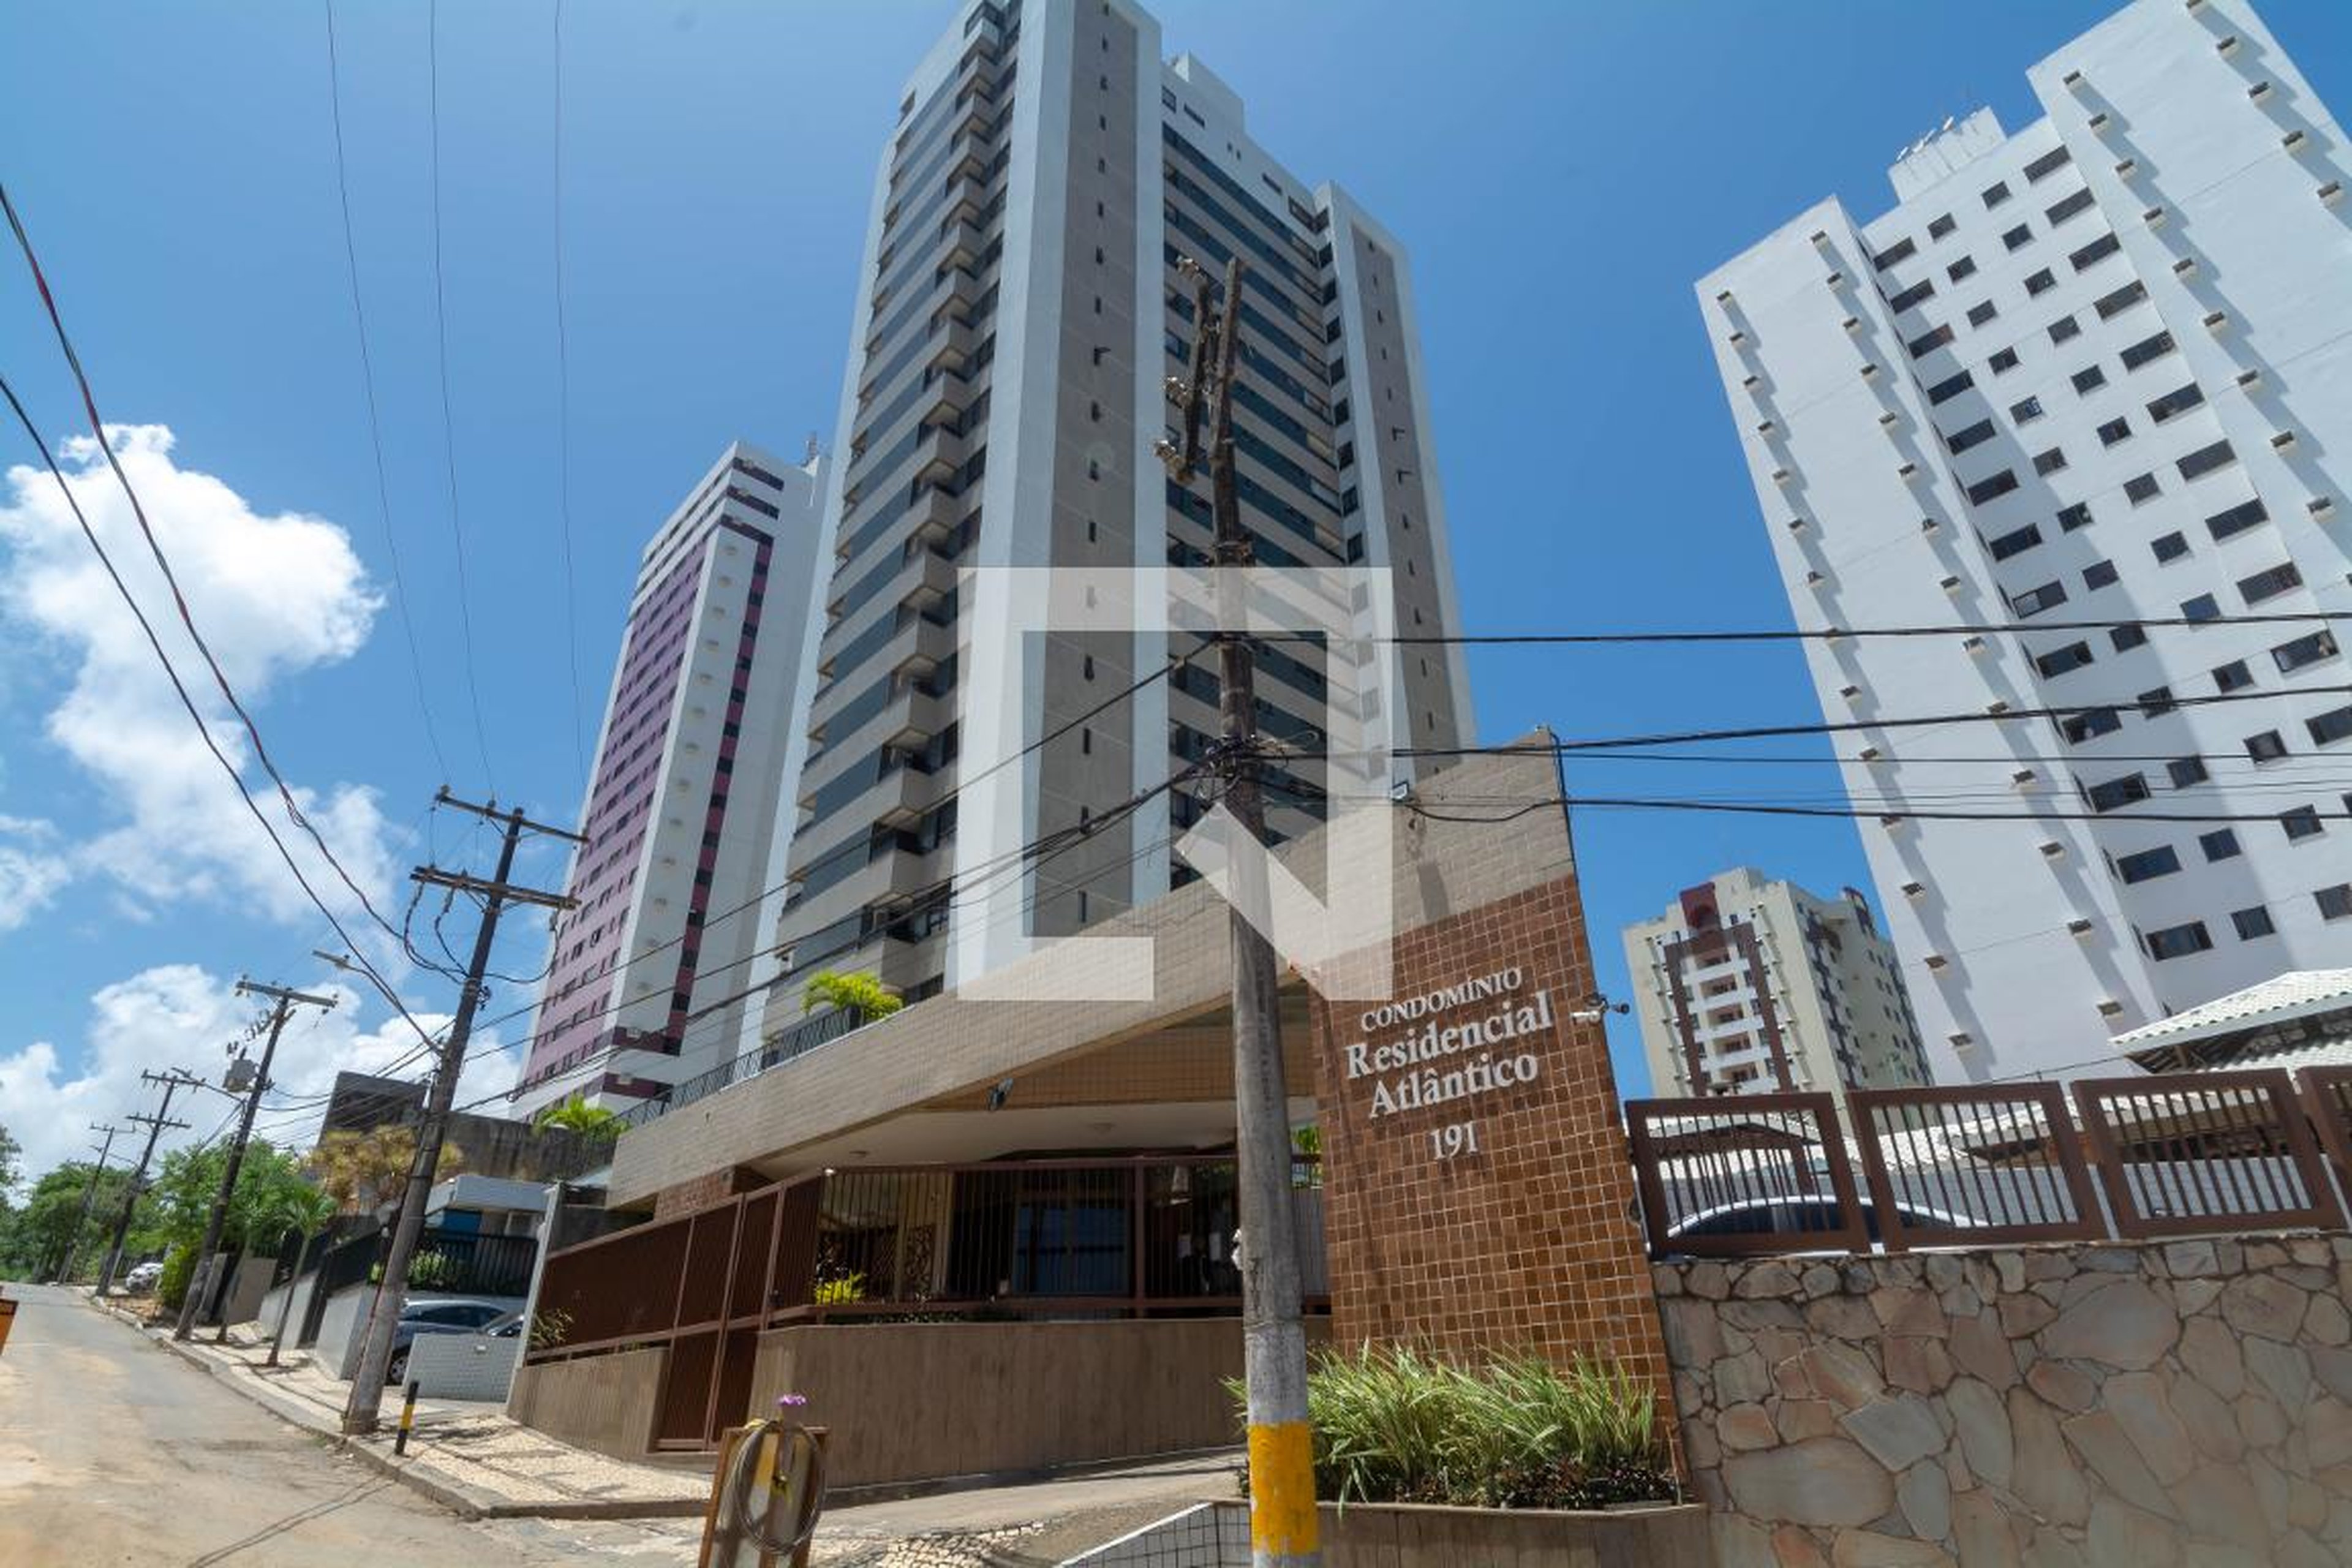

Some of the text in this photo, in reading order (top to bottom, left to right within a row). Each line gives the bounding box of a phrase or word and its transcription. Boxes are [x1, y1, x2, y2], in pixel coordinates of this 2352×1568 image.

[1361, 966, 1523, 1032] CONDOMÍNIO
[1345, 990, 1553, 1080] Residencial
[1369, 1052, 1539, 1118] Atlântico
[1430, 1120, 1478, 1160] 191
